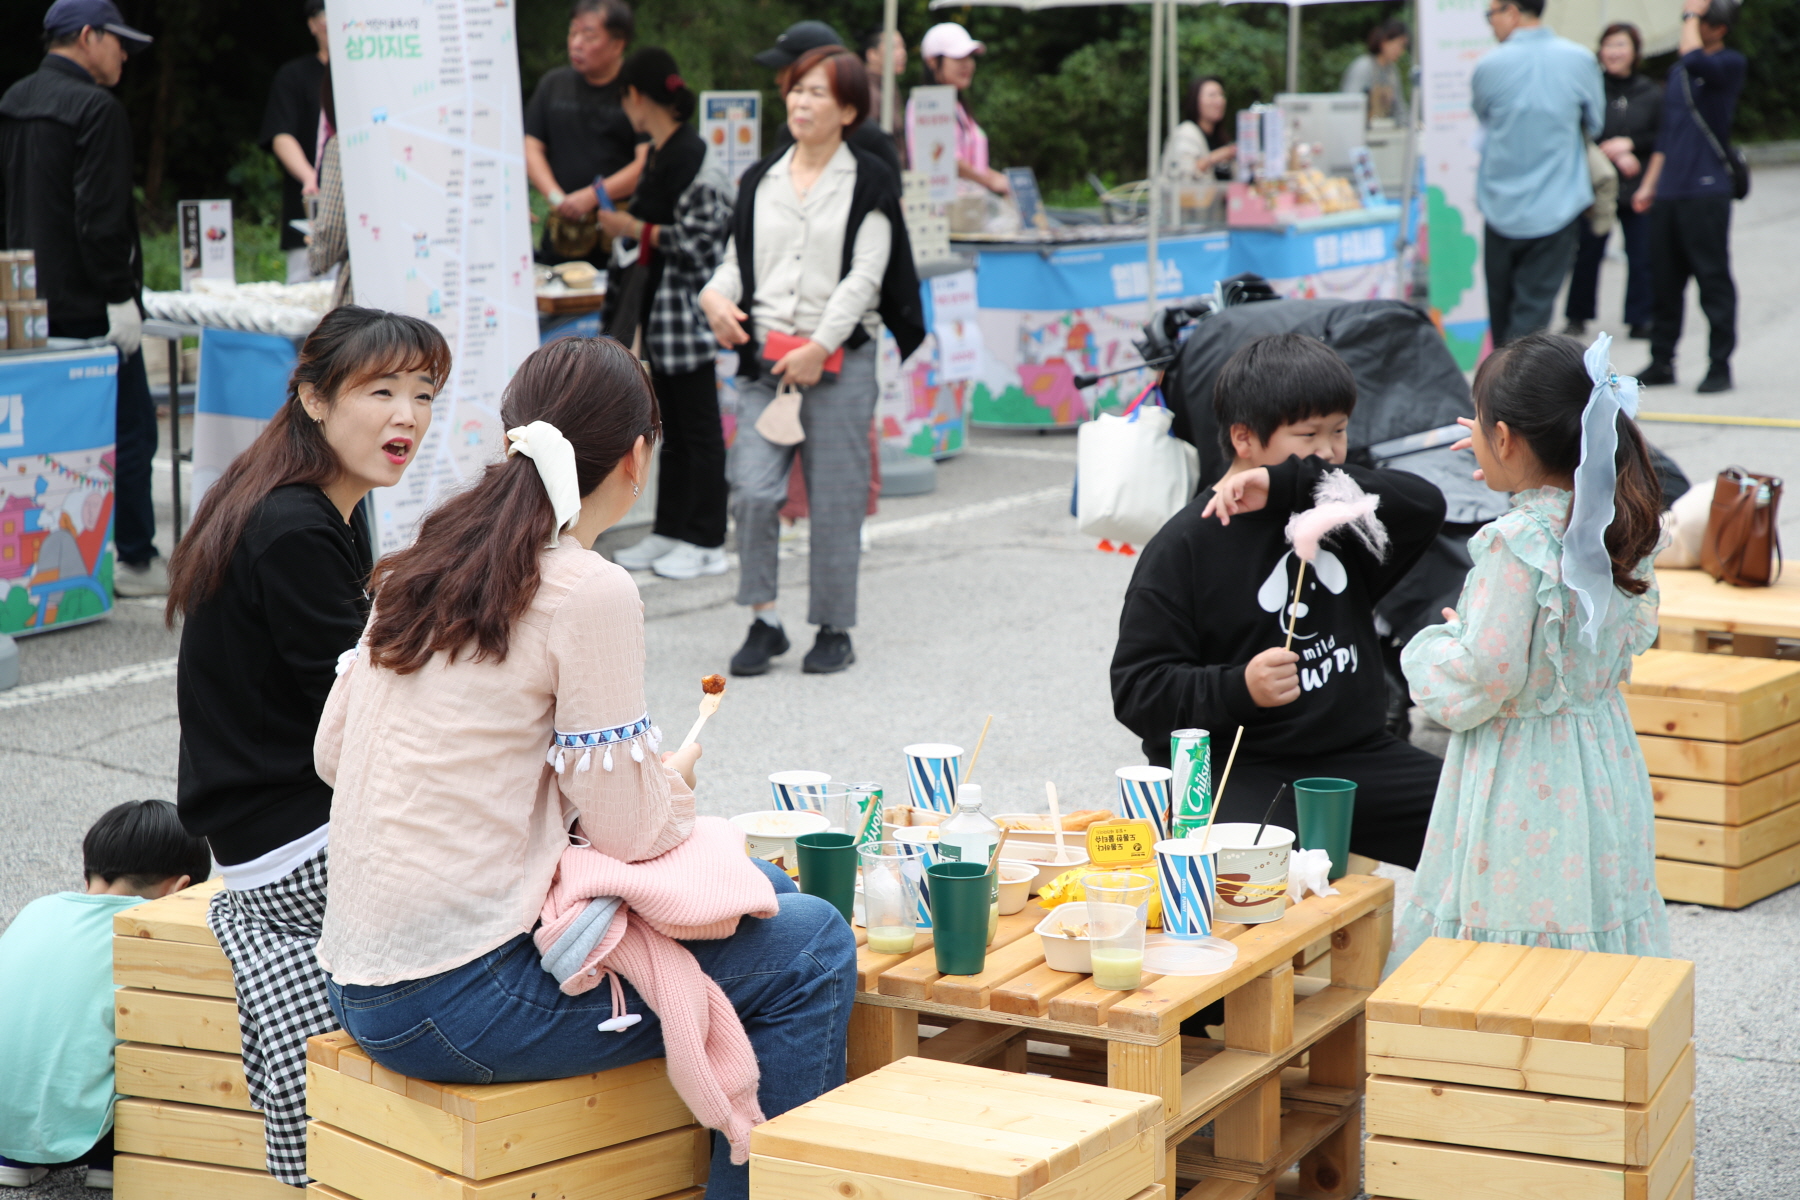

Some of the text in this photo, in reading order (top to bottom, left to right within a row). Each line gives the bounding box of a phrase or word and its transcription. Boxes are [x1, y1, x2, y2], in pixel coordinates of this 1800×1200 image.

[344, 34, 423, 60] 상가지도
[1302, 634, 1336, 661] mild
[1095, 834, 1136, 843] 도톰한 물티슈
